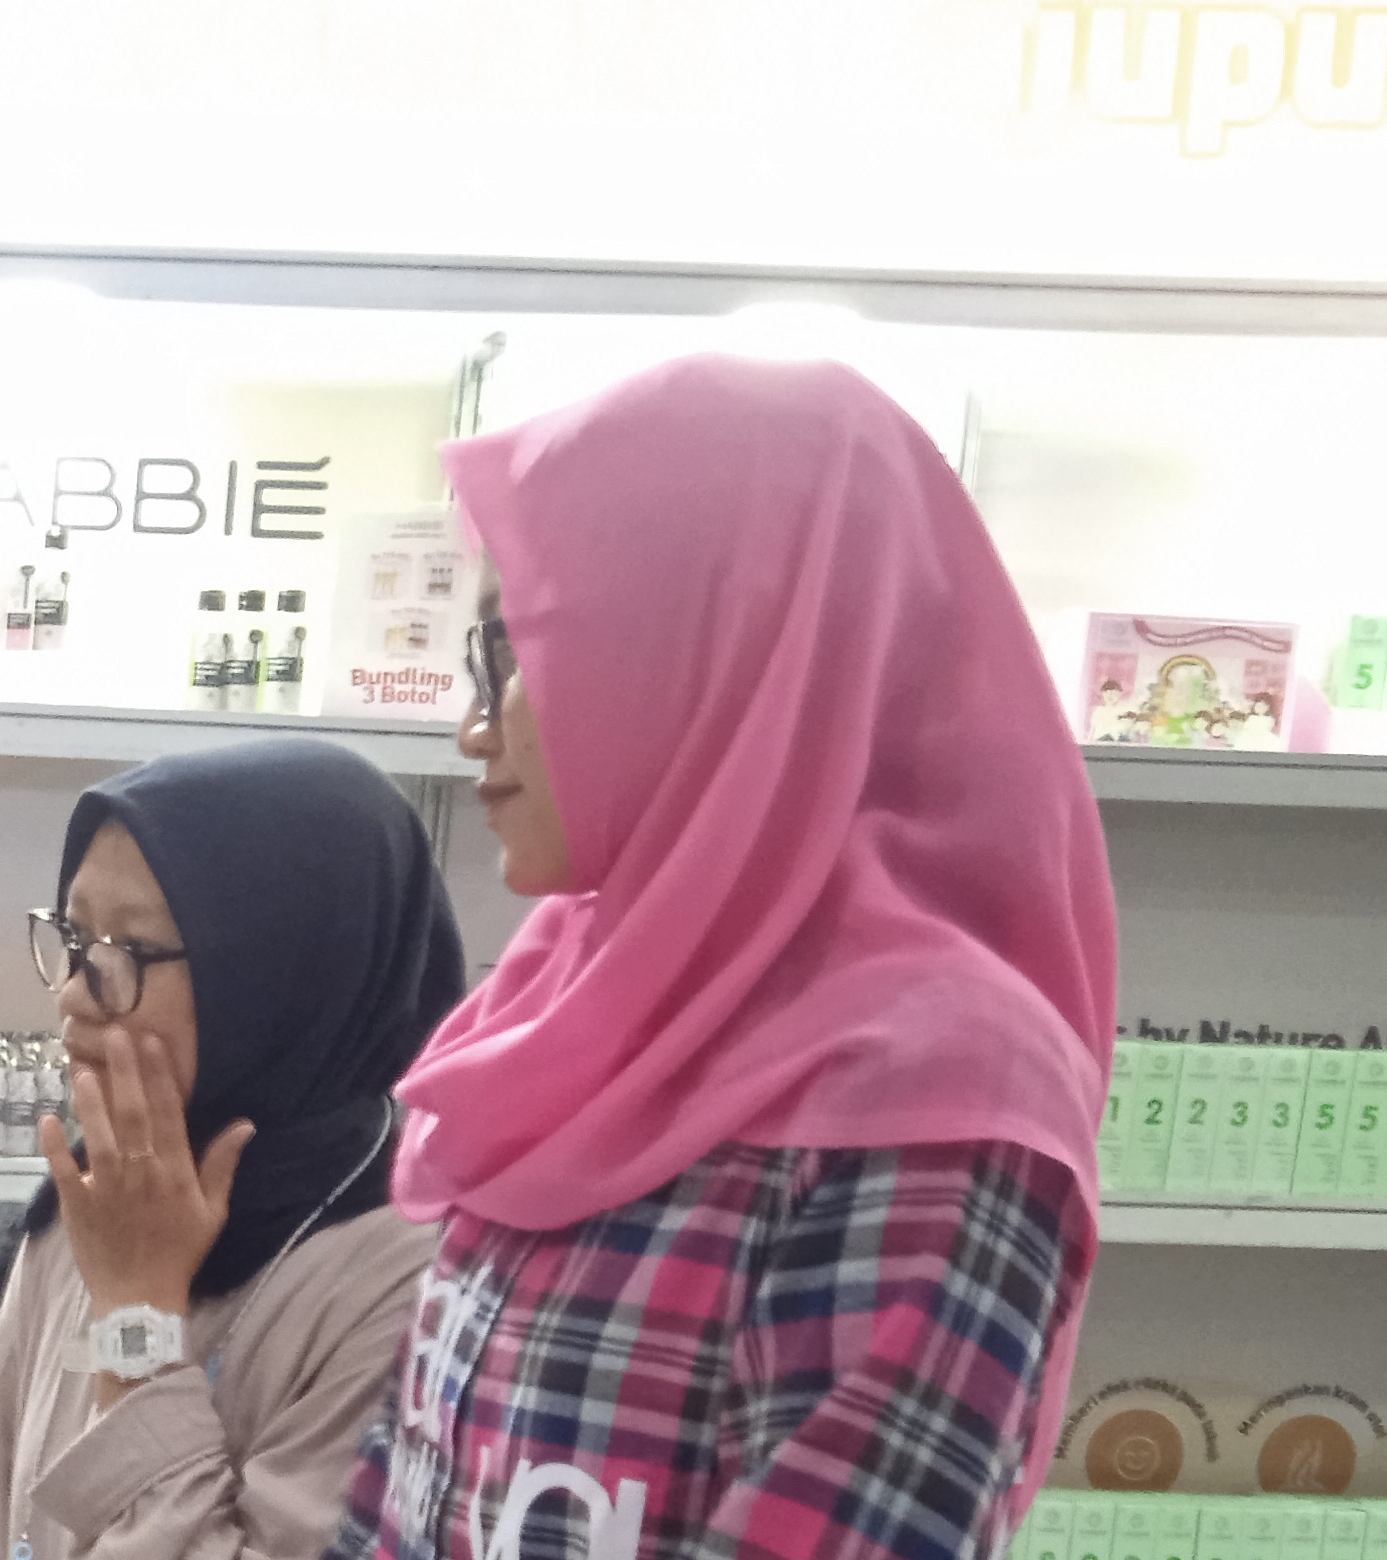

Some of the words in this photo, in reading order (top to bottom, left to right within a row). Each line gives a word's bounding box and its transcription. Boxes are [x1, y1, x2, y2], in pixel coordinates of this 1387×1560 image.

[350, 667, 454, 691] Bundling
[1355, 663, 1374, 690] 5
[363, 686, 375, 704] 3
[382, 685, 437, 705] Botol
[1108, 1096, 1121, 1121] 1
[1145, 1098, 1163, 1125] 2
[1188, 1098, 1207, 1125] 2
[1230, 1101, 1249, 1127] 3
[1272, 1102, 1290, 1128] 3
[1315, 1103, 1335, 1130] 5
[1359, 1105, 1379, 1131] 5
